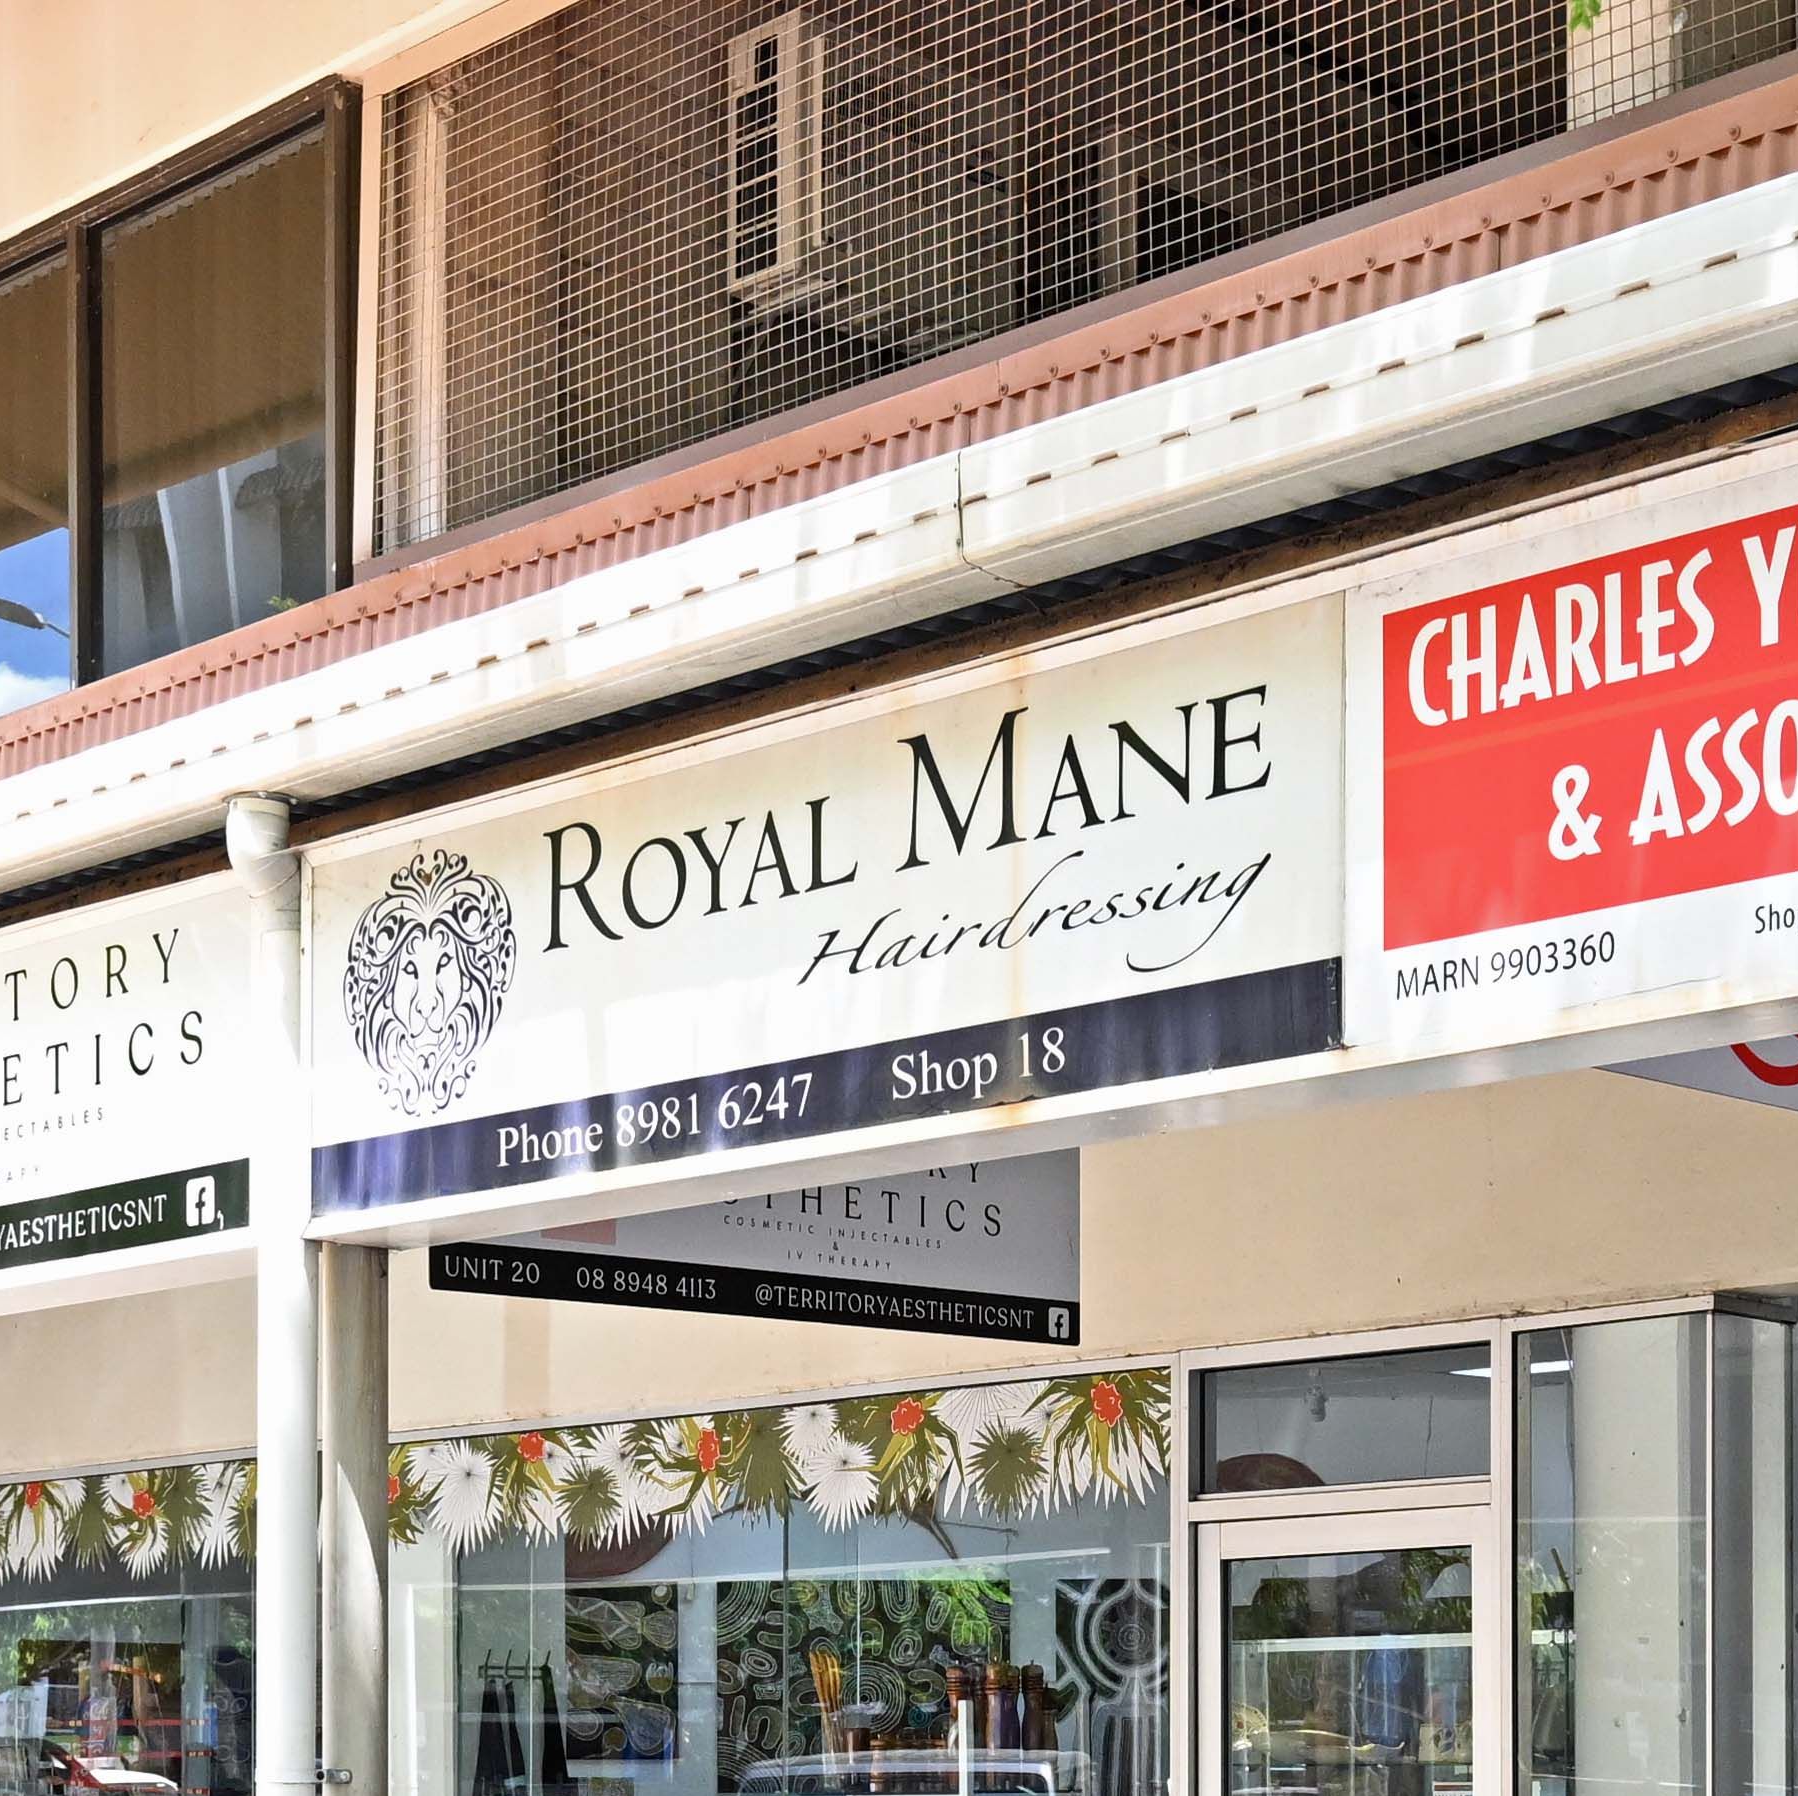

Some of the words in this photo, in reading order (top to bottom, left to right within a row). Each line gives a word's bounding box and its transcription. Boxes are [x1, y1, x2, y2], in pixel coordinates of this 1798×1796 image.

[1408, 548, 1715, 726] CHARLES
[543, 793, 857, 953] ROYAL
[896, 684, 1273, 871] MANE
[1547, 764, 1602, 860] &
[797, 850, 1273, 986] Hairdressing
[1395, 956, 1479, 1001] MARN
[1491, 931, 1615, 981] 9903360
[497, 1112, 603, 1168] Phone
[615, 1091, 702, 1149] 8981
[718, 1074, 814, 1130] 6247
[890, 1045, 999, 1103] Shop
[1017, 1027, 1066, 1080] 18
[724, 1215, 815, 1237] COSMETIC
[828, 1227, 942, 1250] INJECTABLES
[787, 1250, 804, 1261] IV
[818, 1253, 893, 1270] THERAPY
[444, 1255, 503, 1281] UNIT
[511, 1261, 541, 1285] 20
[576, 1267, 605, 1291] 08
[614, 1270, 667, 1296] 8948
[676, 1275, 716, 1299] 4113
[755, 1284, 1035, 1331] @TERRITORYAESTHETICSNT
